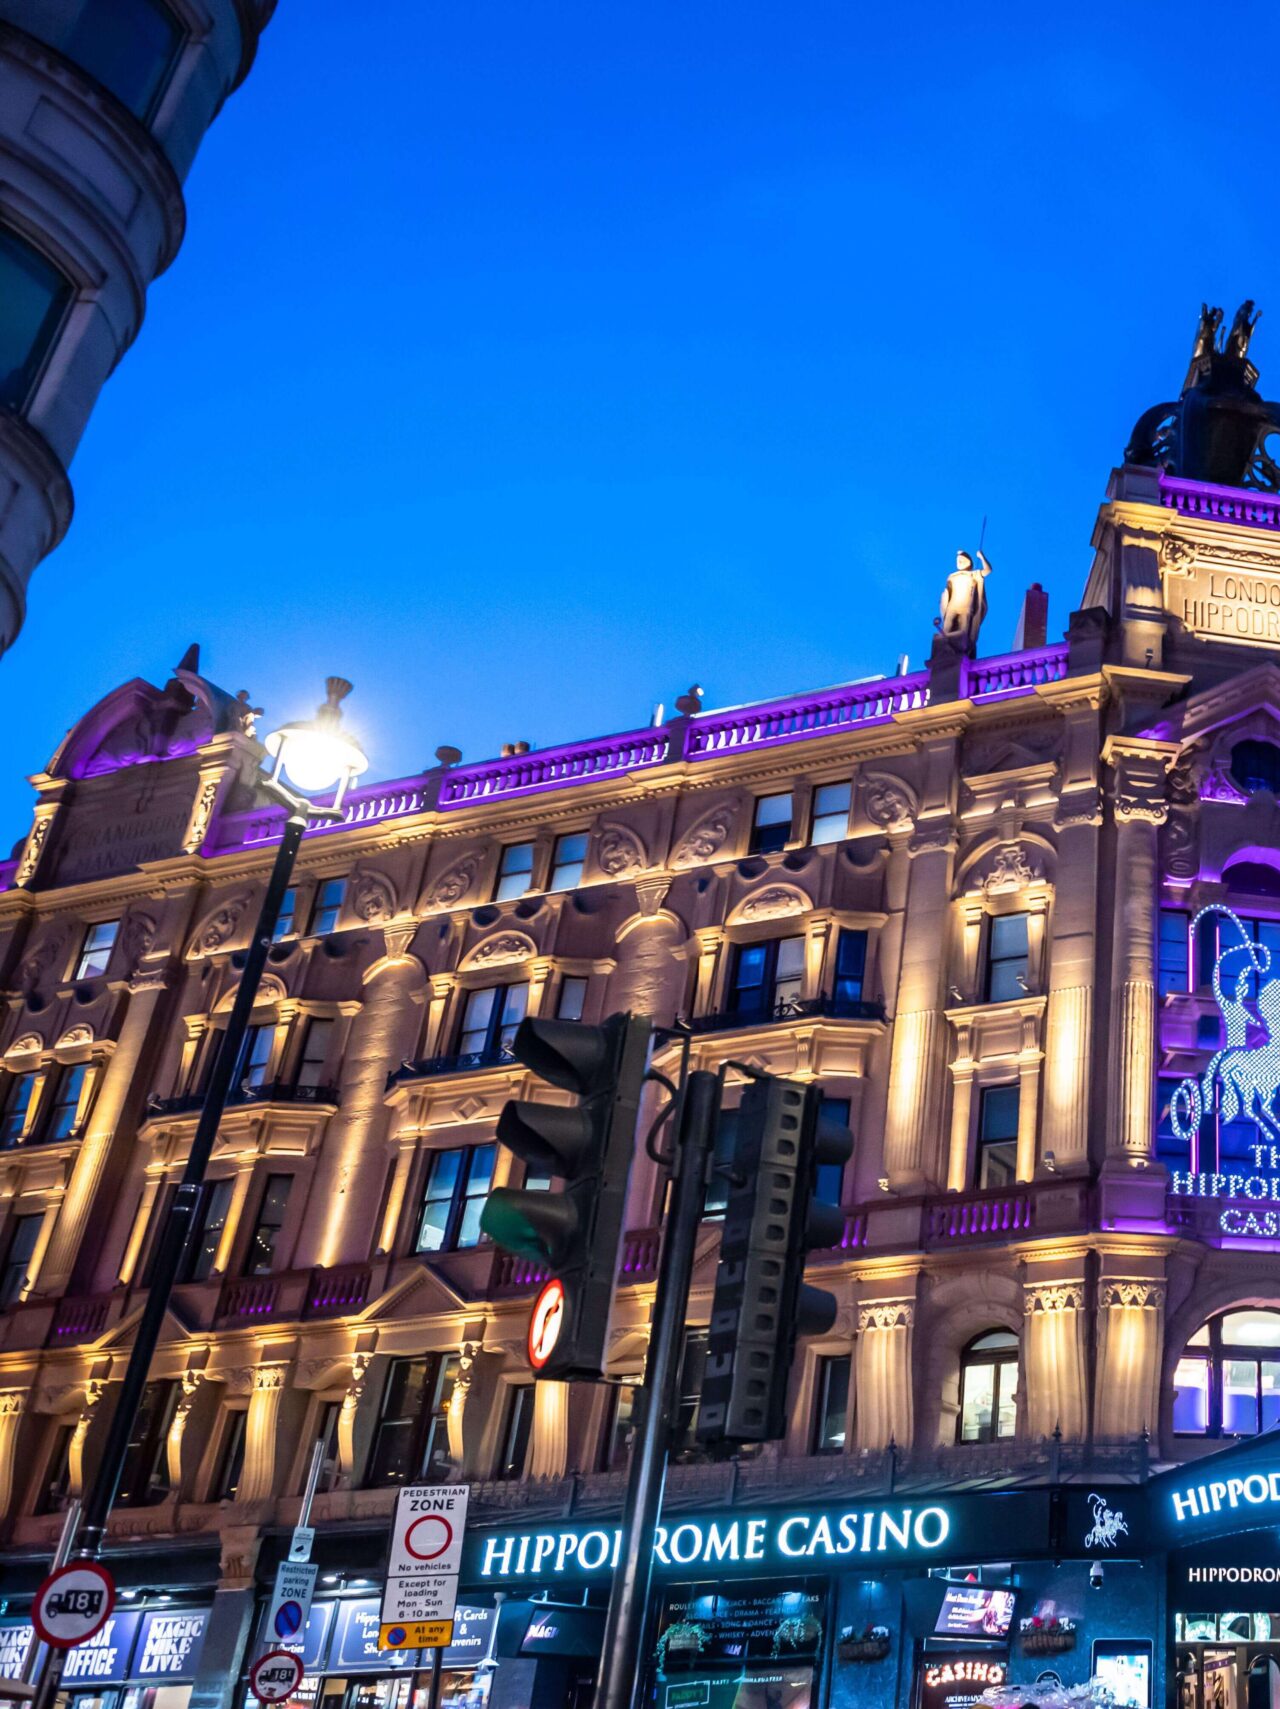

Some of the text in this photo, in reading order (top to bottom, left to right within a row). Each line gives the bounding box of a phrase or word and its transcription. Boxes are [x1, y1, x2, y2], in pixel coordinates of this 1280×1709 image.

[403, 1488, 466, 1498] PEDESTRIAN
[410, 1499, 455, 1512] ZONE
[481, 1507, 950, 1576] HIPPOROME CASINO
[281, 1564, 317, 1575] Restricted
[398, 1562, 452, 1572] No vehicles
[283, 1577, 309, 1587] parking
[398, 1578, 447, 1589] Except for
[281, 1587, 307, 1598] ZONE
[404, 1589, 438, 1598] loading
[68, 1592, 90, 1610] 18
[397, 1600, 417, 1608] Mon
[425, 1599, 443, 1607] Sun
[463, 1609, 488, 1621] Cards
[148, 1620, 205, 1639] MAGIC
[415, 1625, 445, 1634] At any
[459, 1623, 467, 1635] &
[418, 1635, 438, 1643] time
[143, 1636, 193, 1656] MIKE
[63, 1647, 118, 1677] OFFICE
[139, 1654, 185, 1673] LIVE
[926, 1661, 1004, 1687] CASINO
